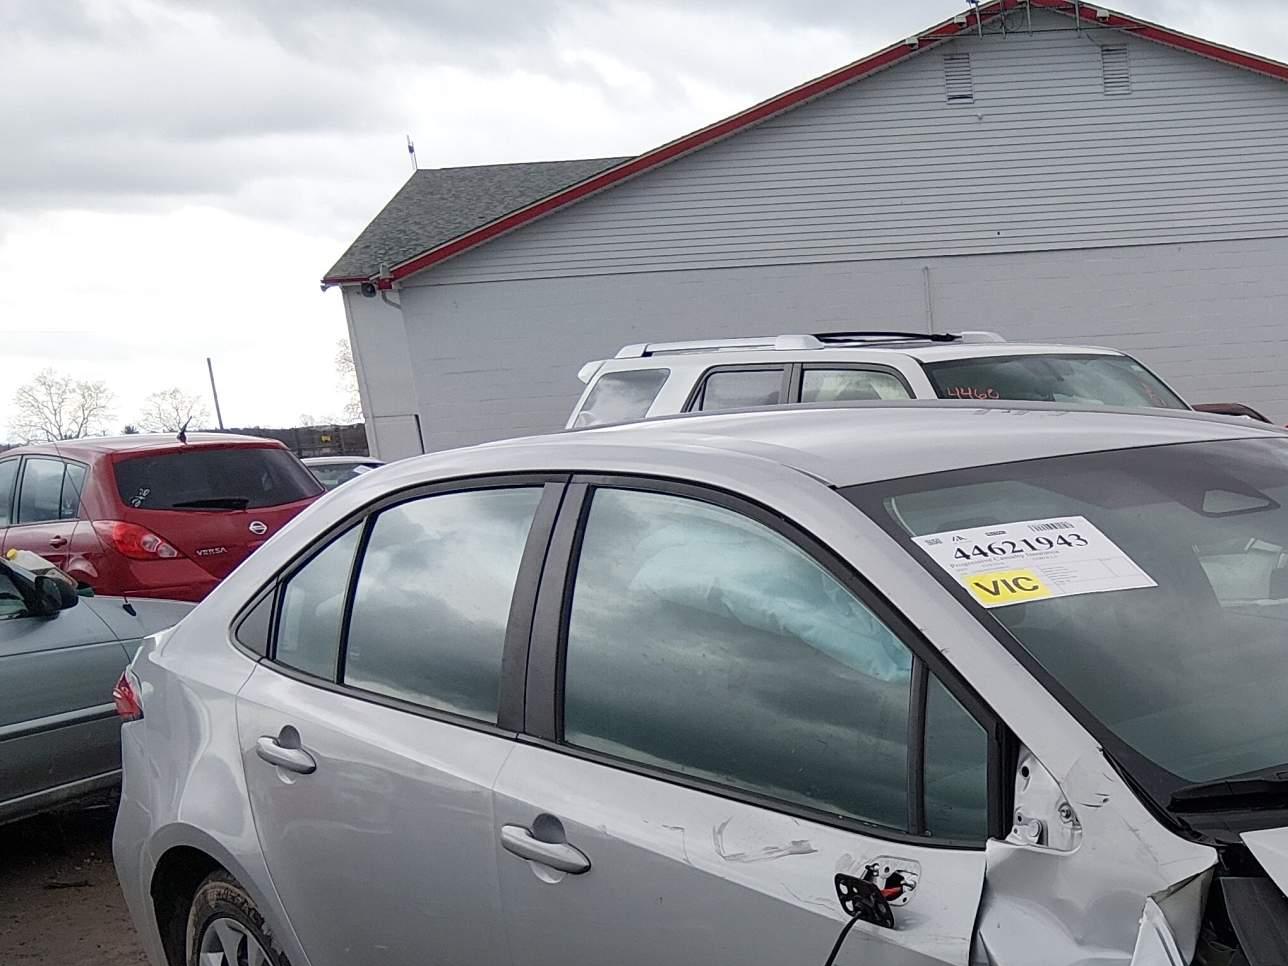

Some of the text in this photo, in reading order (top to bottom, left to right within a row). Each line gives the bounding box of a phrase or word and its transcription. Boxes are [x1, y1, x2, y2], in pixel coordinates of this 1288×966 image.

[196, 546, 228, 556] VERSA
[954, 533, 1089, 560] 44621943
[973, 576, 1040, 596] VIC
